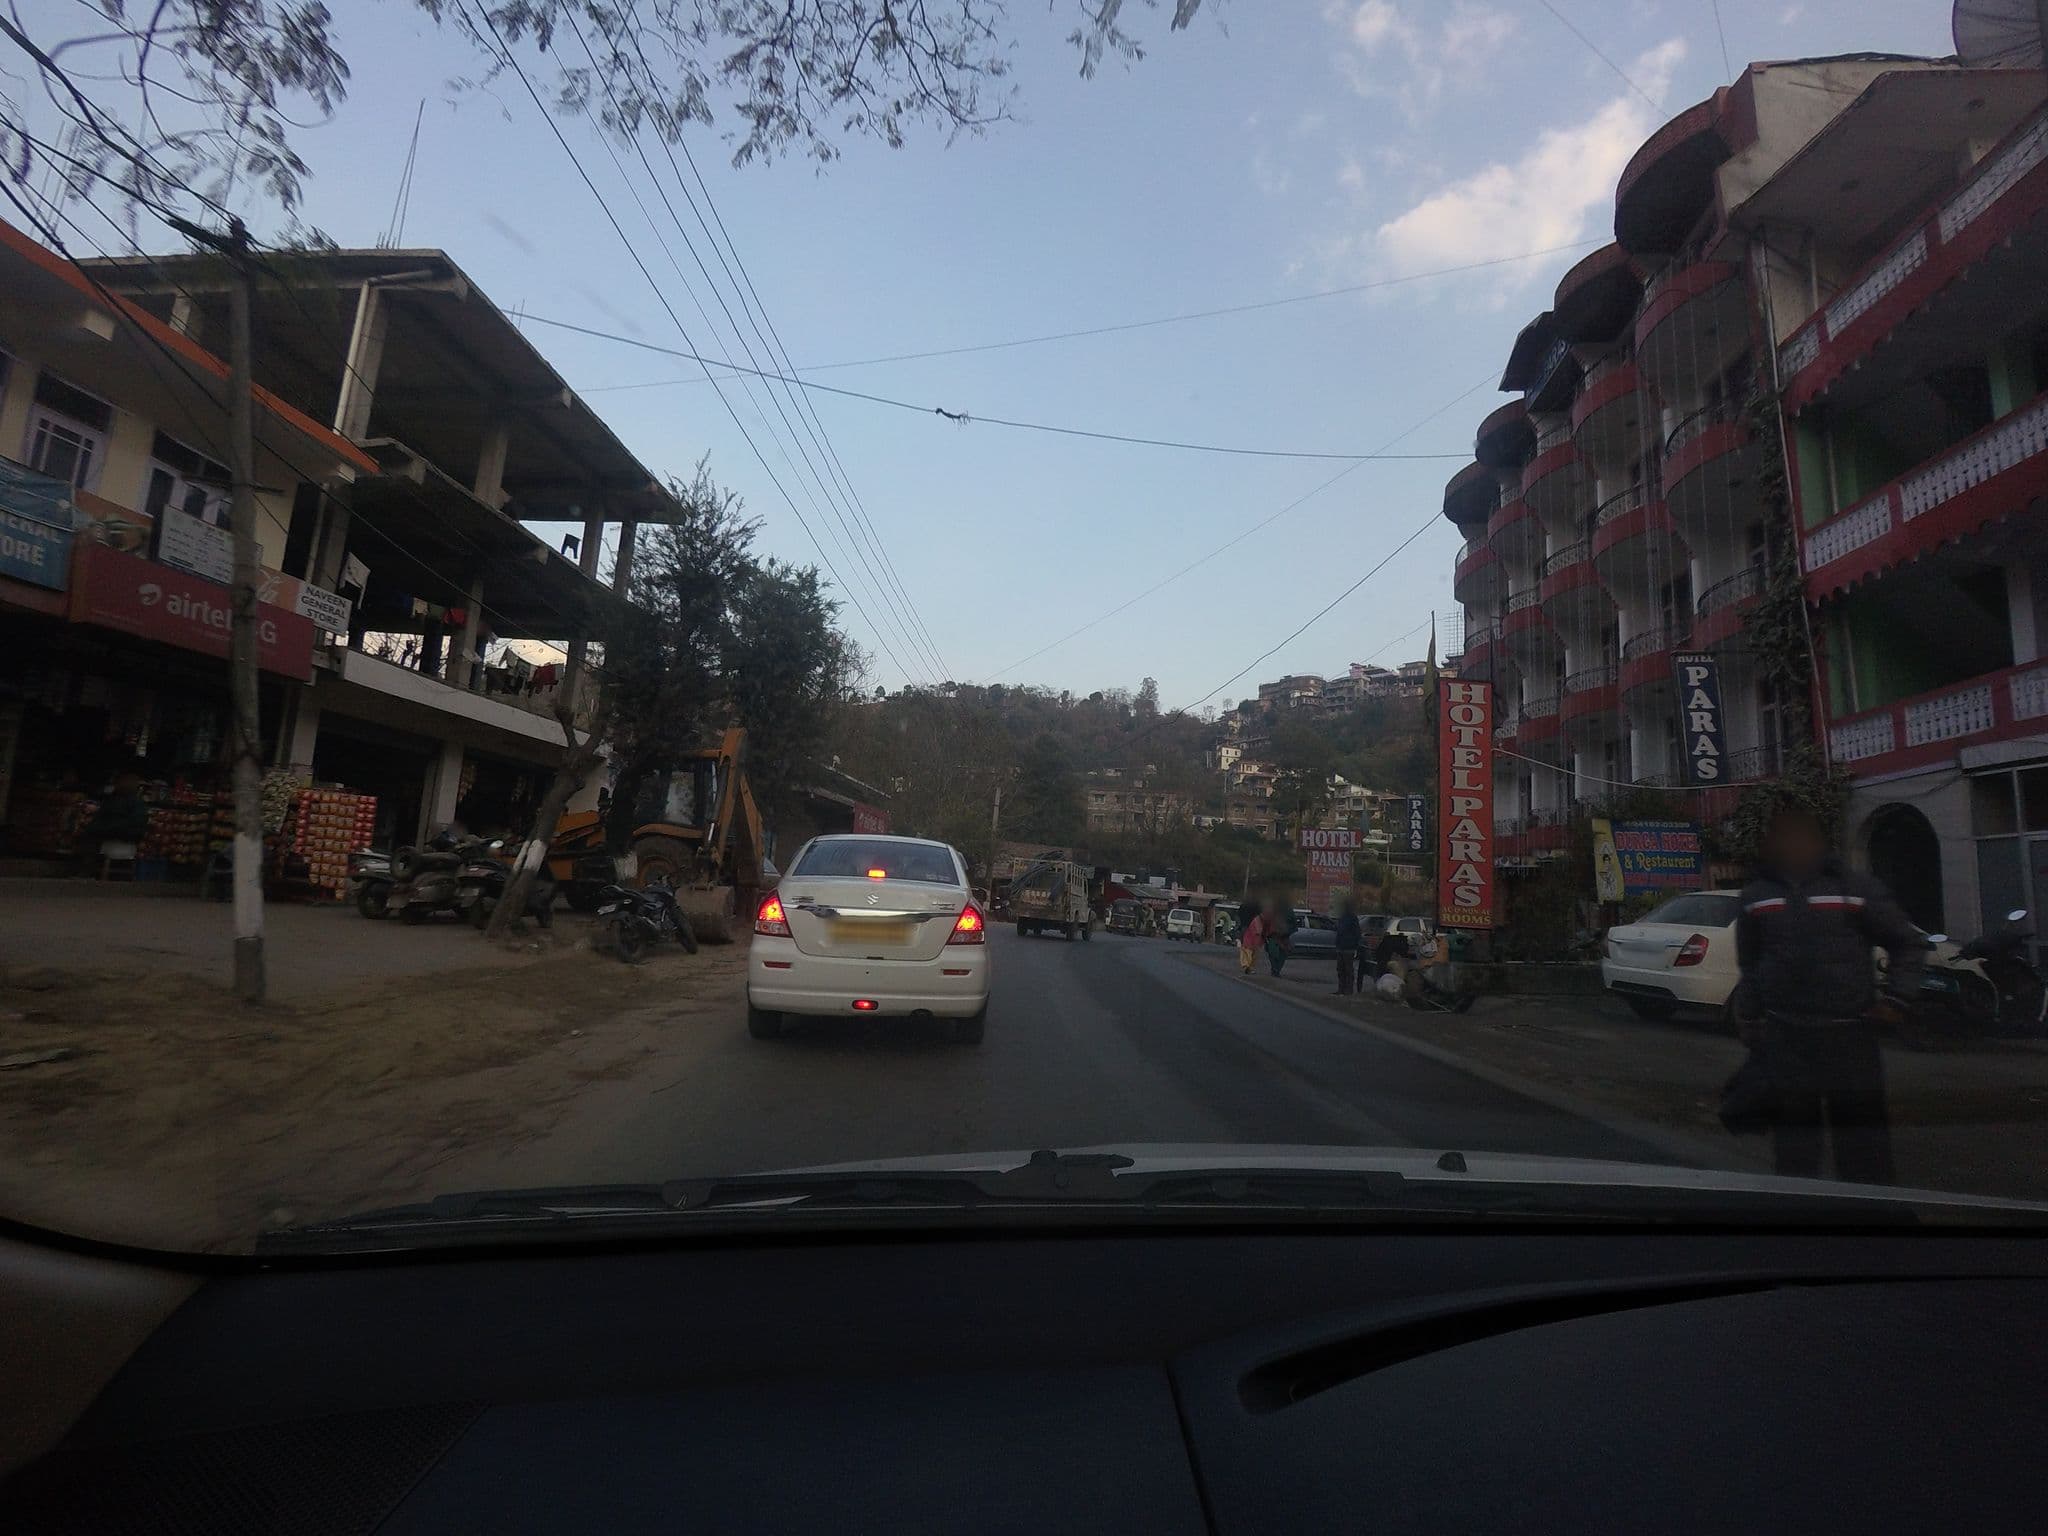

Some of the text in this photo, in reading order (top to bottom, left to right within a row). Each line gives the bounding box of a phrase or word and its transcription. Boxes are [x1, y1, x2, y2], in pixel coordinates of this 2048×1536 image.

[301, 595, 345, 619] GENERAL
[305, 586, 346, 608] NAVEEN
[166, 593, 232, 631] airtel
[306, 608, 338, 626] STORE
[1685, 666, 1720, 780] PARAS
[1447, 683, 1487, 907] HOTEL PARAS
[1410, 800, 1423, 850] PARAS
[1301, 830, 1361, 848] HOTEL
[1615, 831, 1657, 851] DURGA
[1312, 850, 1351, 867] PARAS
[1624, 854, 1633, 870] &
[1442, 913, 1493, 925] ROOMS
